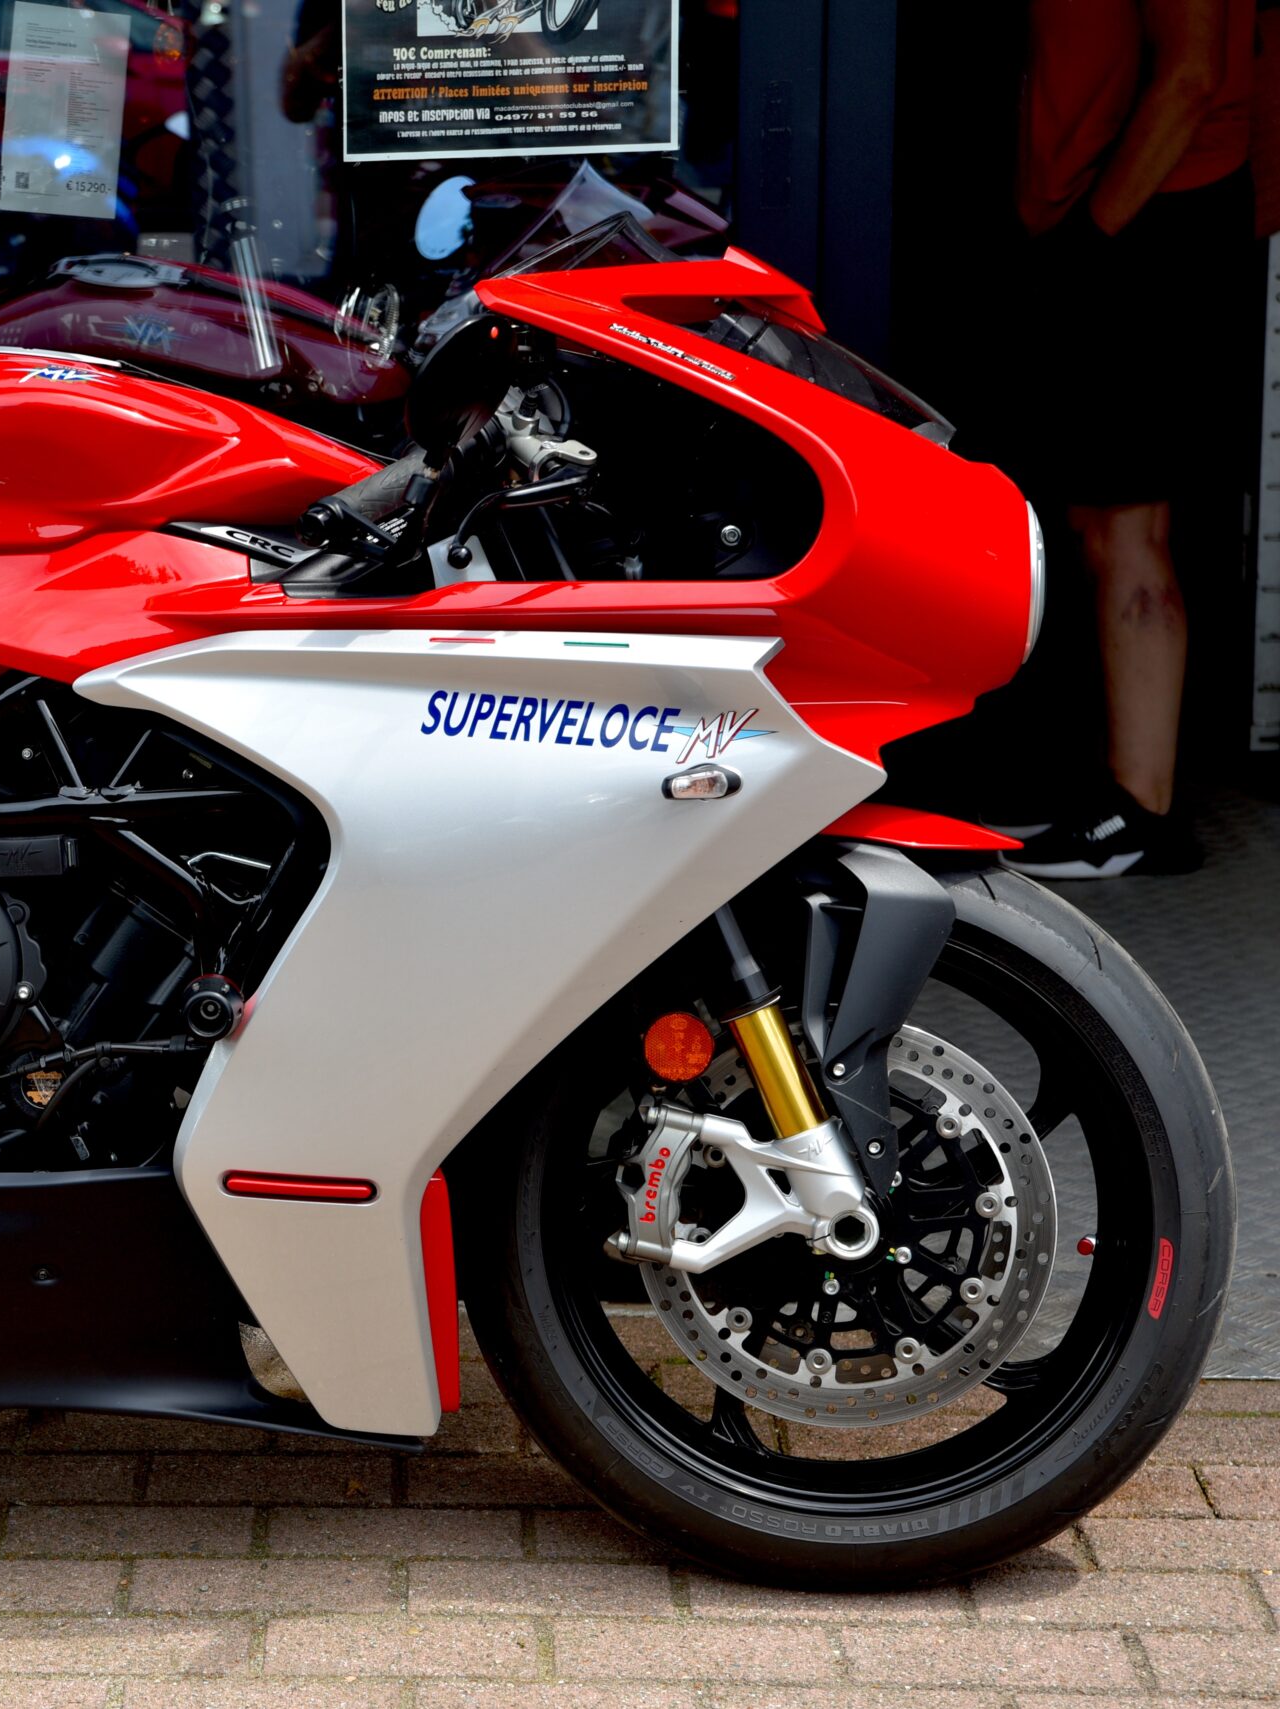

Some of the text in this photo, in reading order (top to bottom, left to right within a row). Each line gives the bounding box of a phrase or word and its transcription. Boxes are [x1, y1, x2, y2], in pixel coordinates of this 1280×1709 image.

[393, 46, 491, 61] 40€ Comprenant:
[438, 86, 469, 98] Places
[472, 84, 511, 97] limitées
[513, 83, 569, 96] uniquement
[573, 83, 590, 93] sur
[593, 80, 648, 93] inscription
[407, 110, 419, 122] et
[421, 108, 474, 122] inscription
[559, 111, 576, 119] 59
[581, 110, 598, 118] 56
[226, 530, 296, 559] CRC
[420, 690, 759, 764] SUPERVELOCE MV
[640, 1147, 671, 1224] brembo
[1150, 1244, 1172, 1312] CORSA
[604, 1420, 665, 1476] CORSA
[676, 1483, 713, 1503] IV
[824, 1518, 930, 1538] DIABLO
